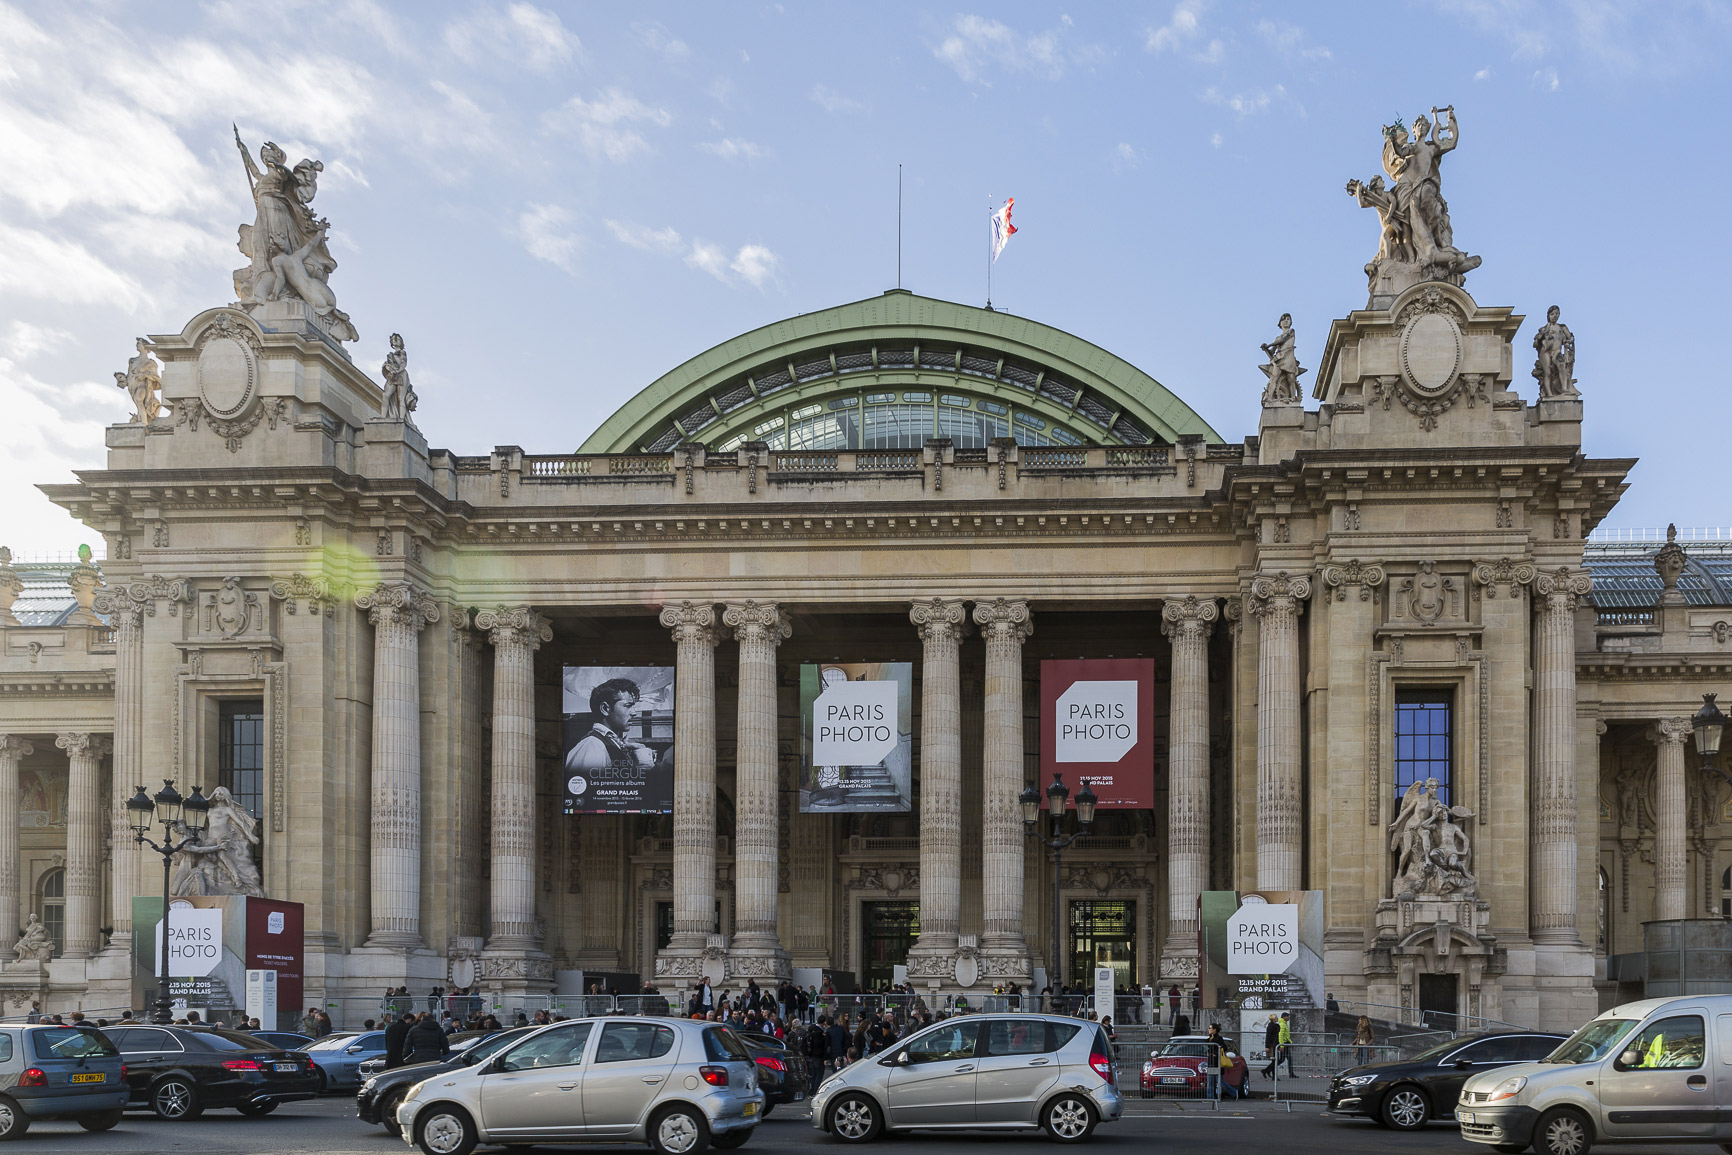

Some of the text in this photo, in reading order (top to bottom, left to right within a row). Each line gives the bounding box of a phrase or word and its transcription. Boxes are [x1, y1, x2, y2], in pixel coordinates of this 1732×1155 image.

[828, 704, 884, 720] PARIS
[1070, 704, 1124, 719] PARIS
[820, 726, 890, 742] PHOTO
[1063, 724, 1130, 740] PHOTO
[590, 767, 646, 778] CLERGUE
[168, 928, 211, 940] PARIS
[1239, 924, 1286, 936] PARIS
[172, 945, 216, 958] HOTO
[1234, 942, 1292, 954] PHOTO
